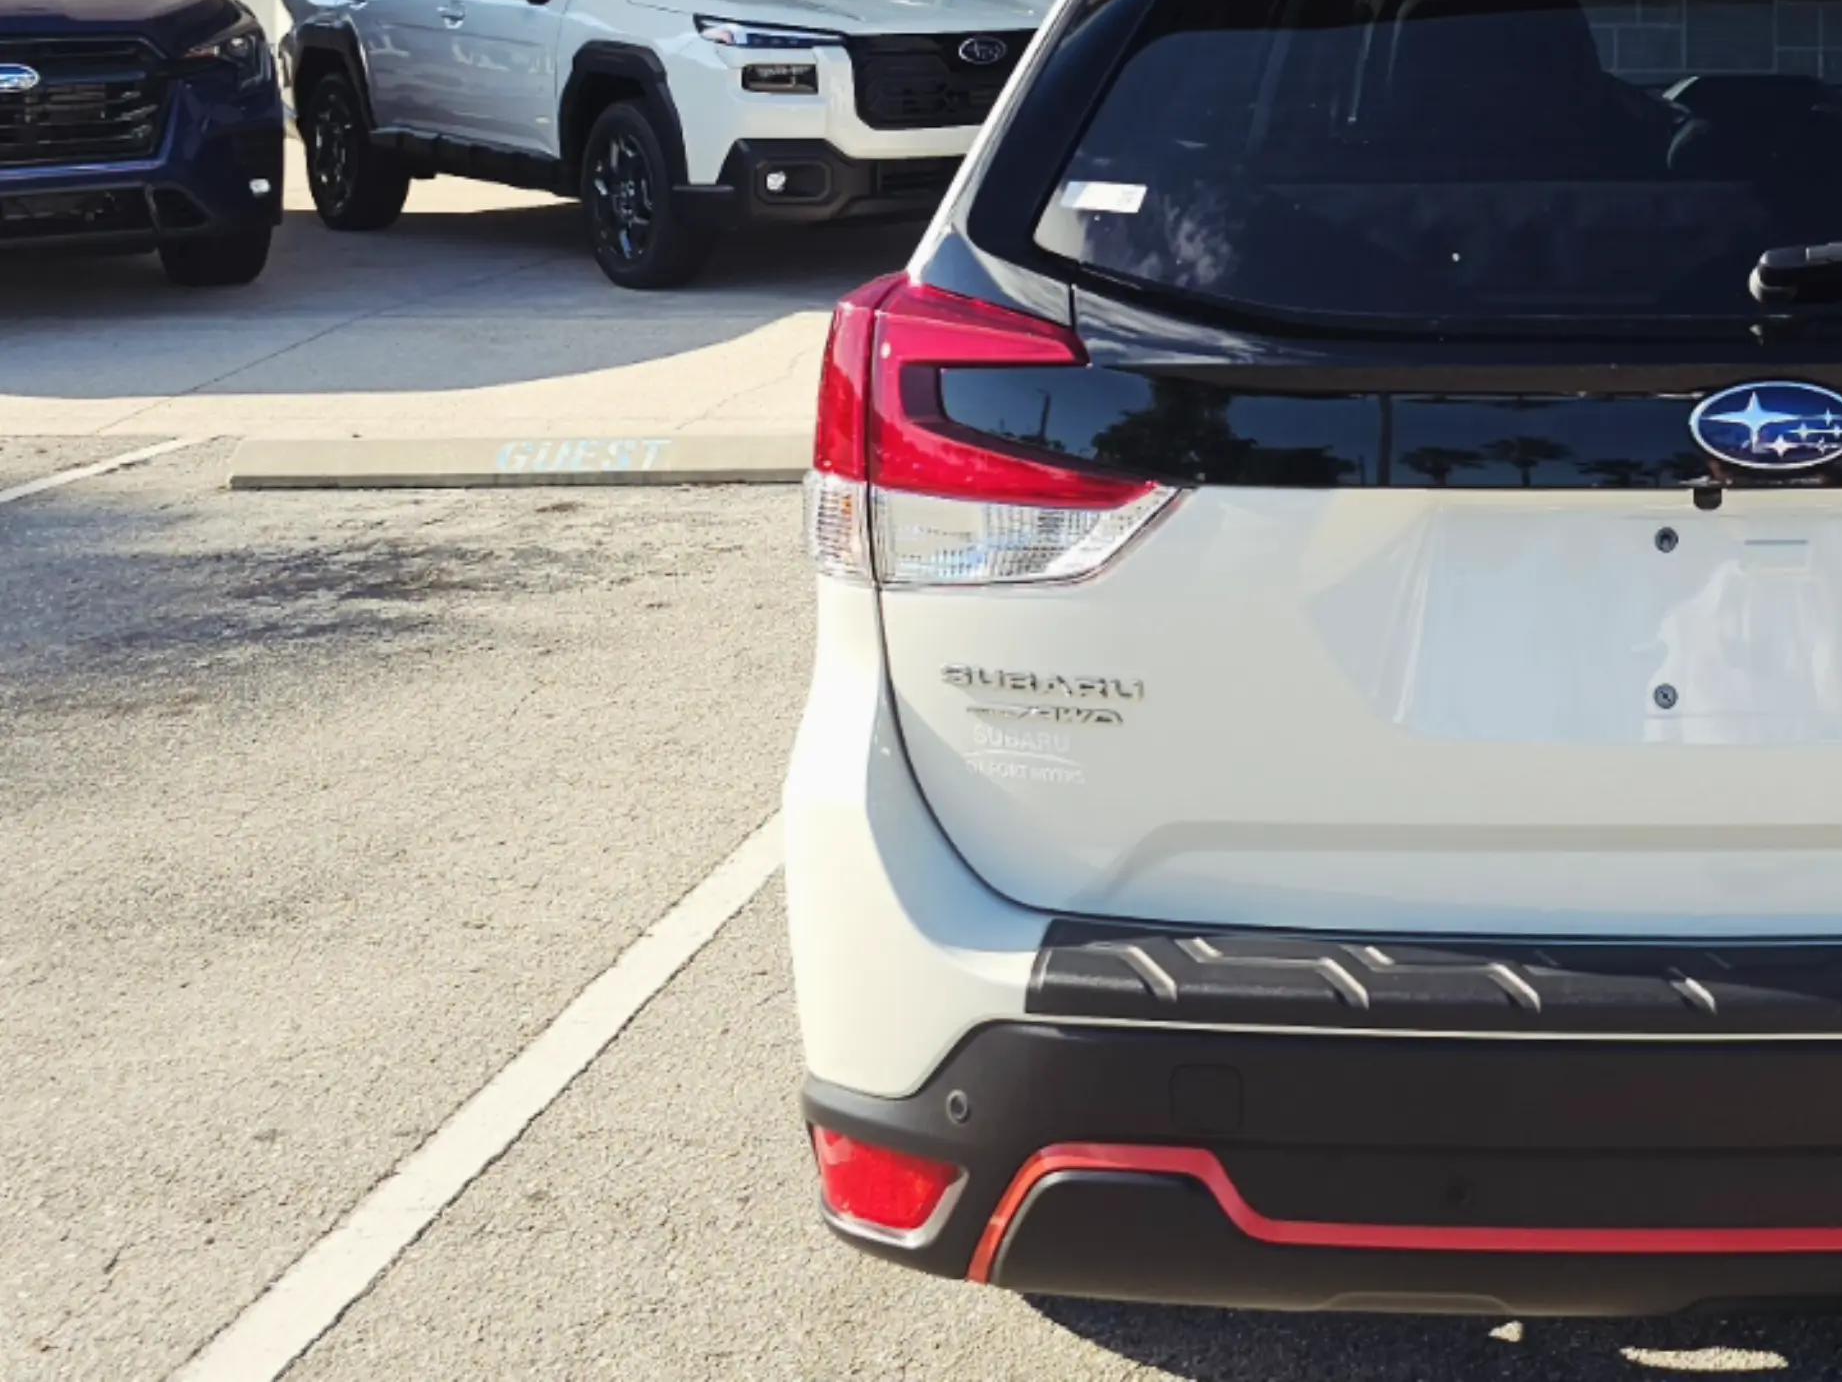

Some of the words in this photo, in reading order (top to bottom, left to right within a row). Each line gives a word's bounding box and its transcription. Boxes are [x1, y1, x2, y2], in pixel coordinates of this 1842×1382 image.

[496, 438, 672, 472] GUEST
[942, 662, 1145, 702] SUBARU
[973, 724, 1071, 753] SUBARU
